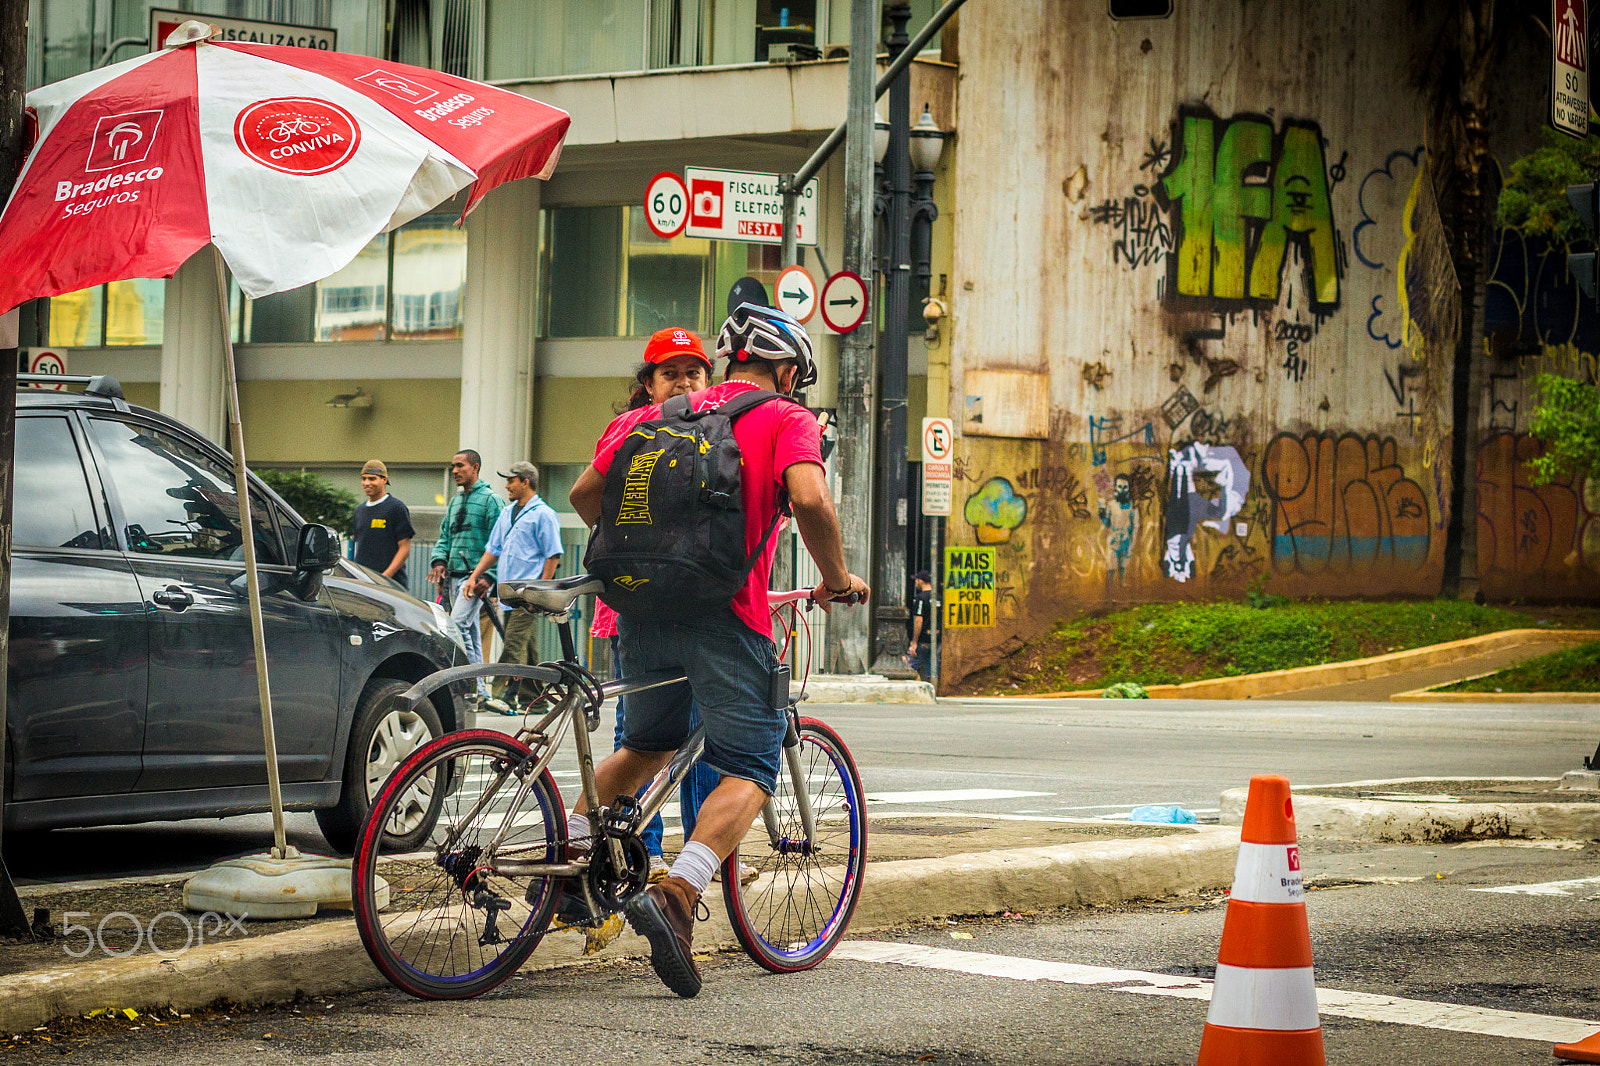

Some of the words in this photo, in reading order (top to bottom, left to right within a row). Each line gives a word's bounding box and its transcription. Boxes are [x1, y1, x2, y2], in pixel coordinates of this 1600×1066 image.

[211, 28, 329, 51] ISCALIZAÇÃO
[1565, 71, 1579, 93] SÓ
[413, 93, 475, 122] Bradesco
[1556, 90, 1587, 114] ATRAVESSE
[447, 106, 495, 129] Seguros
[1556, 107, 1565, 121] NO
[1567, 111, 1586, 129] VERDE
[269, 133, 345, 159] CONVIVA
[54, 166, 164, 202] Bradesco
[62, 190, 140, 219] Seguros
[653, 192, 682, 215] 60
[657, 218, 676, 228] km/h
[739, 221, 777, 236] NESTA
[615, 448, 666, 526] EVERLAST
[950, 552, 990, 570] MAIS
[947, 571, 993, 590] AMOR
[959, 591, 982, 602] POR
[948, 603, 991, 625] FAVOR
